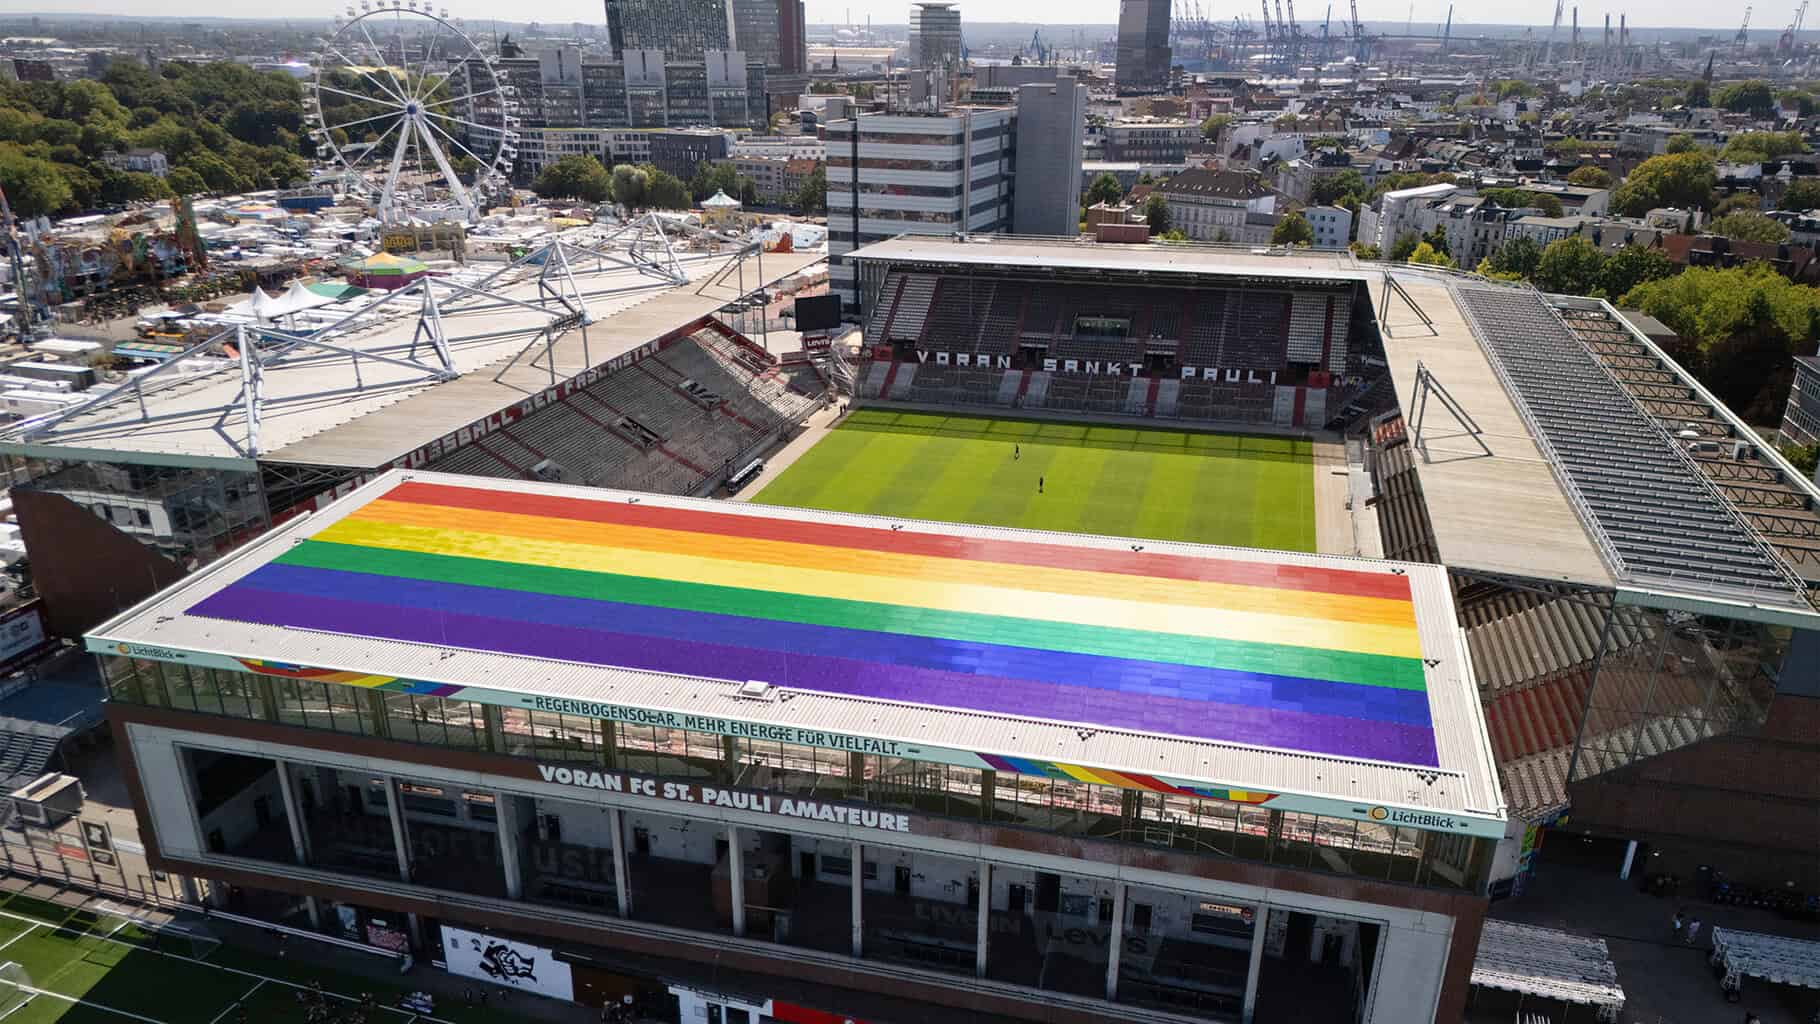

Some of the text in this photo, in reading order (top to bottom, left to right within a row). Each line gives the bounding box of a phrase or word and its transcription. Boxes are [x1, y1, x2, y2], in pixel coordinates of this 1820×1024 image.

[917, 350, 1277, 385] VORAN SANKT PAULI
[535, 695, 902, 756] REGENBOGENSOLAR. MEHR ENERGIE FÜR VIELFALT.
[538, 764, 909, 833] VORAN FC ST. PAULI AMATEURE
[1392, 810, 1456, 829] LichtBlick
